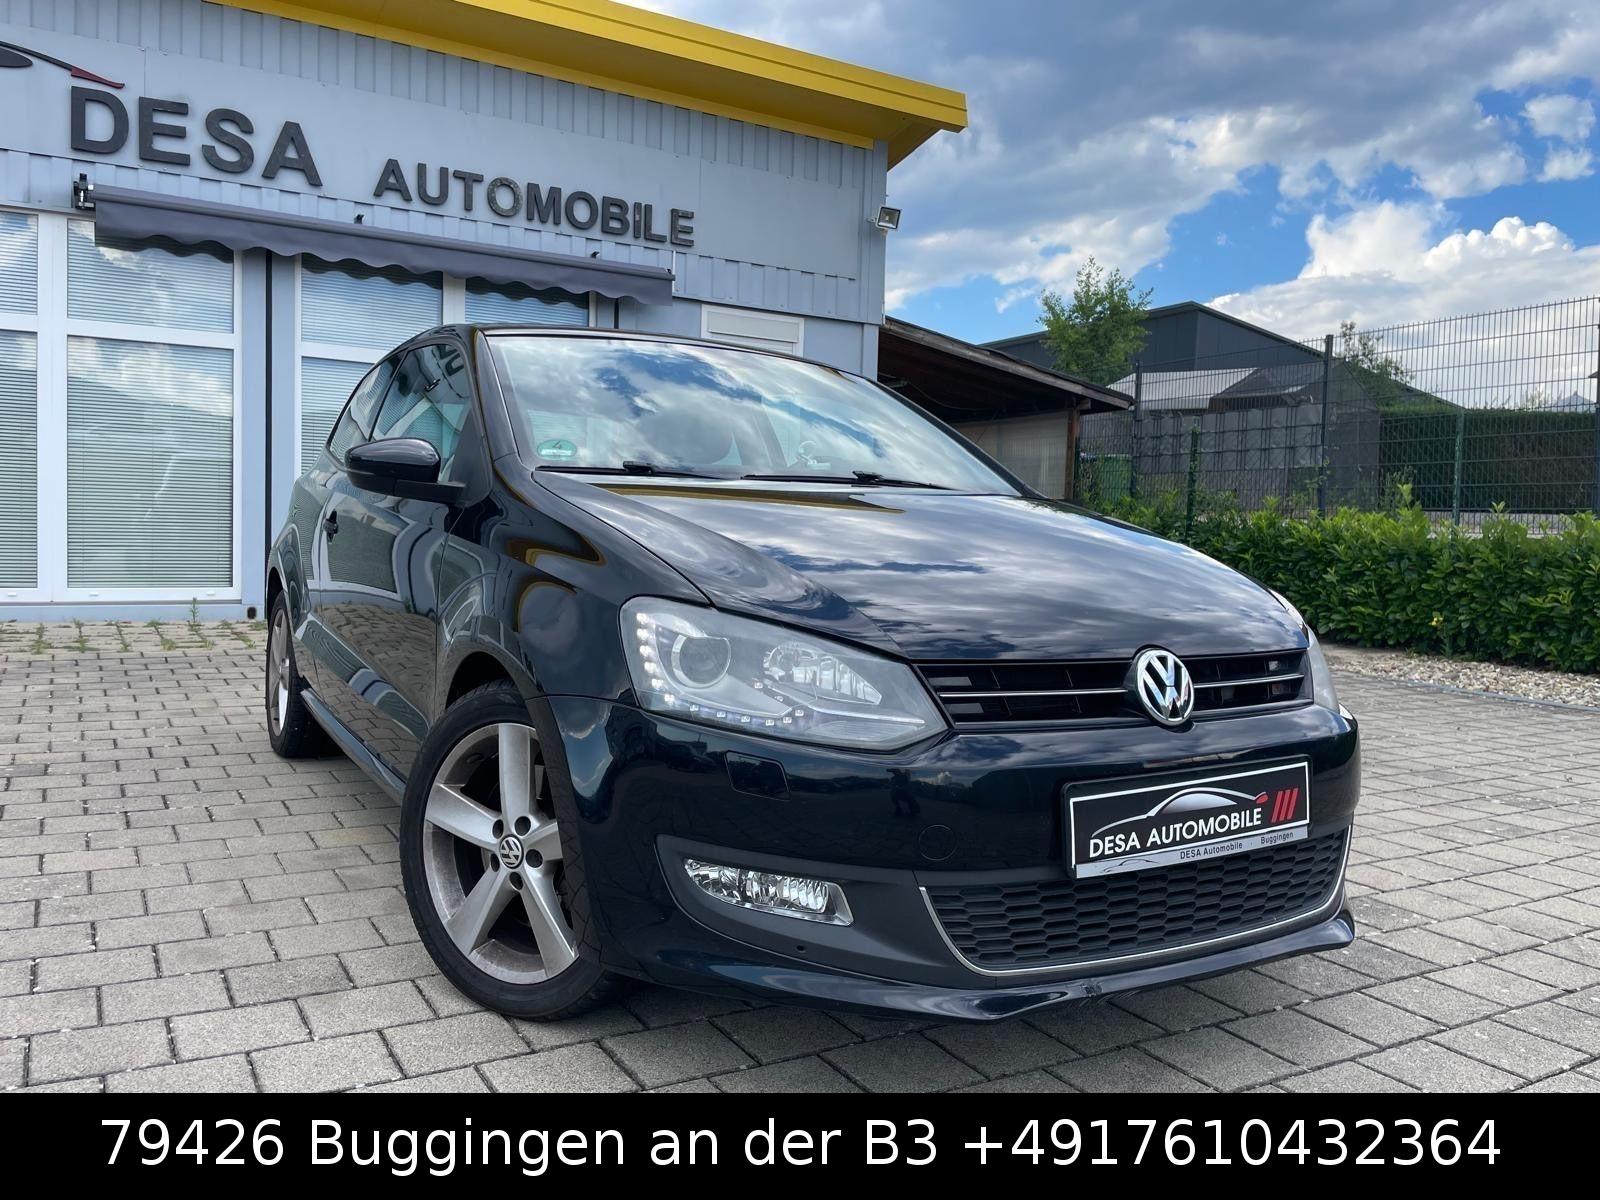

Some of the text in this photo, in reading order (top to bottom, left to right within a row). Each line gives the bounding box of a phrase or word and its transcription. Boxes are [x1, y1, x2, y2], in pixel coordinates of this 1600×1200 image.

[70, 85, 696, 247] DESA AUTOMOBILE
[1137, 649, 1194, 725] VW
[1089, 807, 1262, 858] DESA AUTOMOBILE
[1180, 831, 1294, 860] DESA Automobile Buggingen
